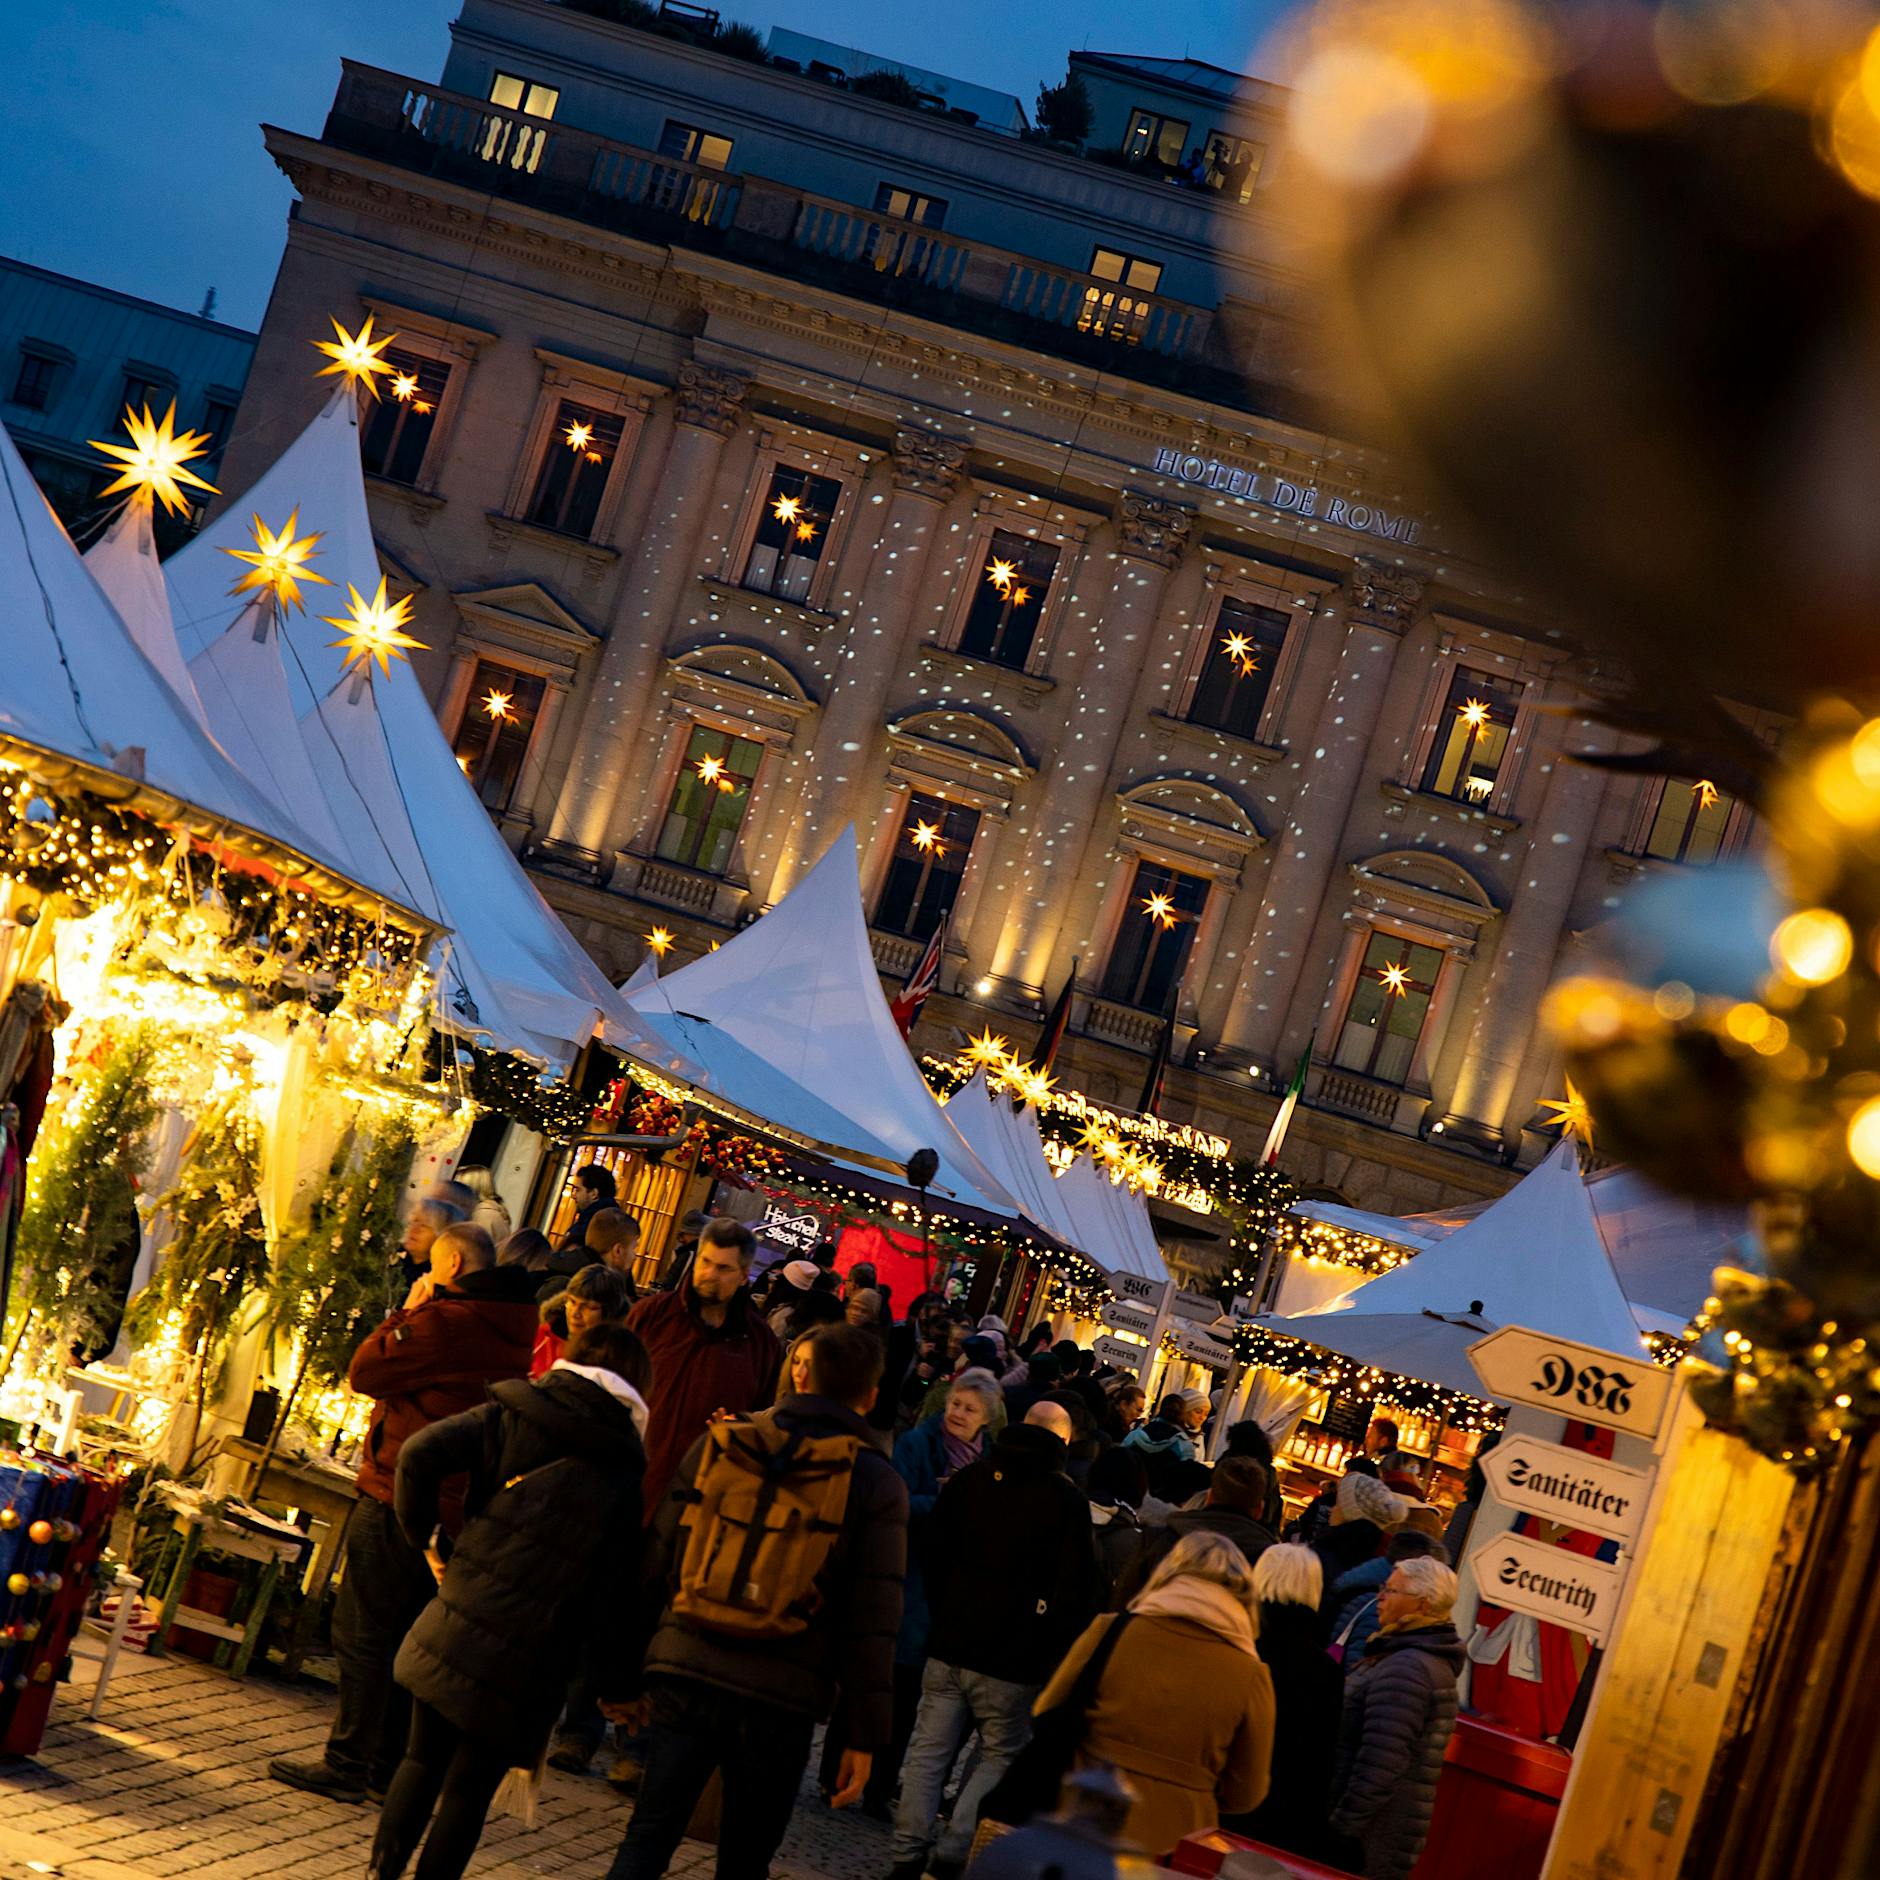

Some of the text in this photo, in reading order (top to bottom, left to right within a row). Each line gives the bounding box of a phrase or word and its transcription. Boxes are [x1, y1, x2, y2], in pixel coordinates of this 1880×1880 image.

[1154, 448, 1421, 545] HOTEL DE ROME
[1124, 1279, 1152, 1297] WC
[1109, 1310, 1148, 1329] Sanitäter
[1101, 1343, 1137, 1362] Security
[1186, 1341, 1229, 1361] Sanitäter
[1507, 1458, 1630, 1517] Sanitäter
[1499, 1557, 1597, 1617] Security
